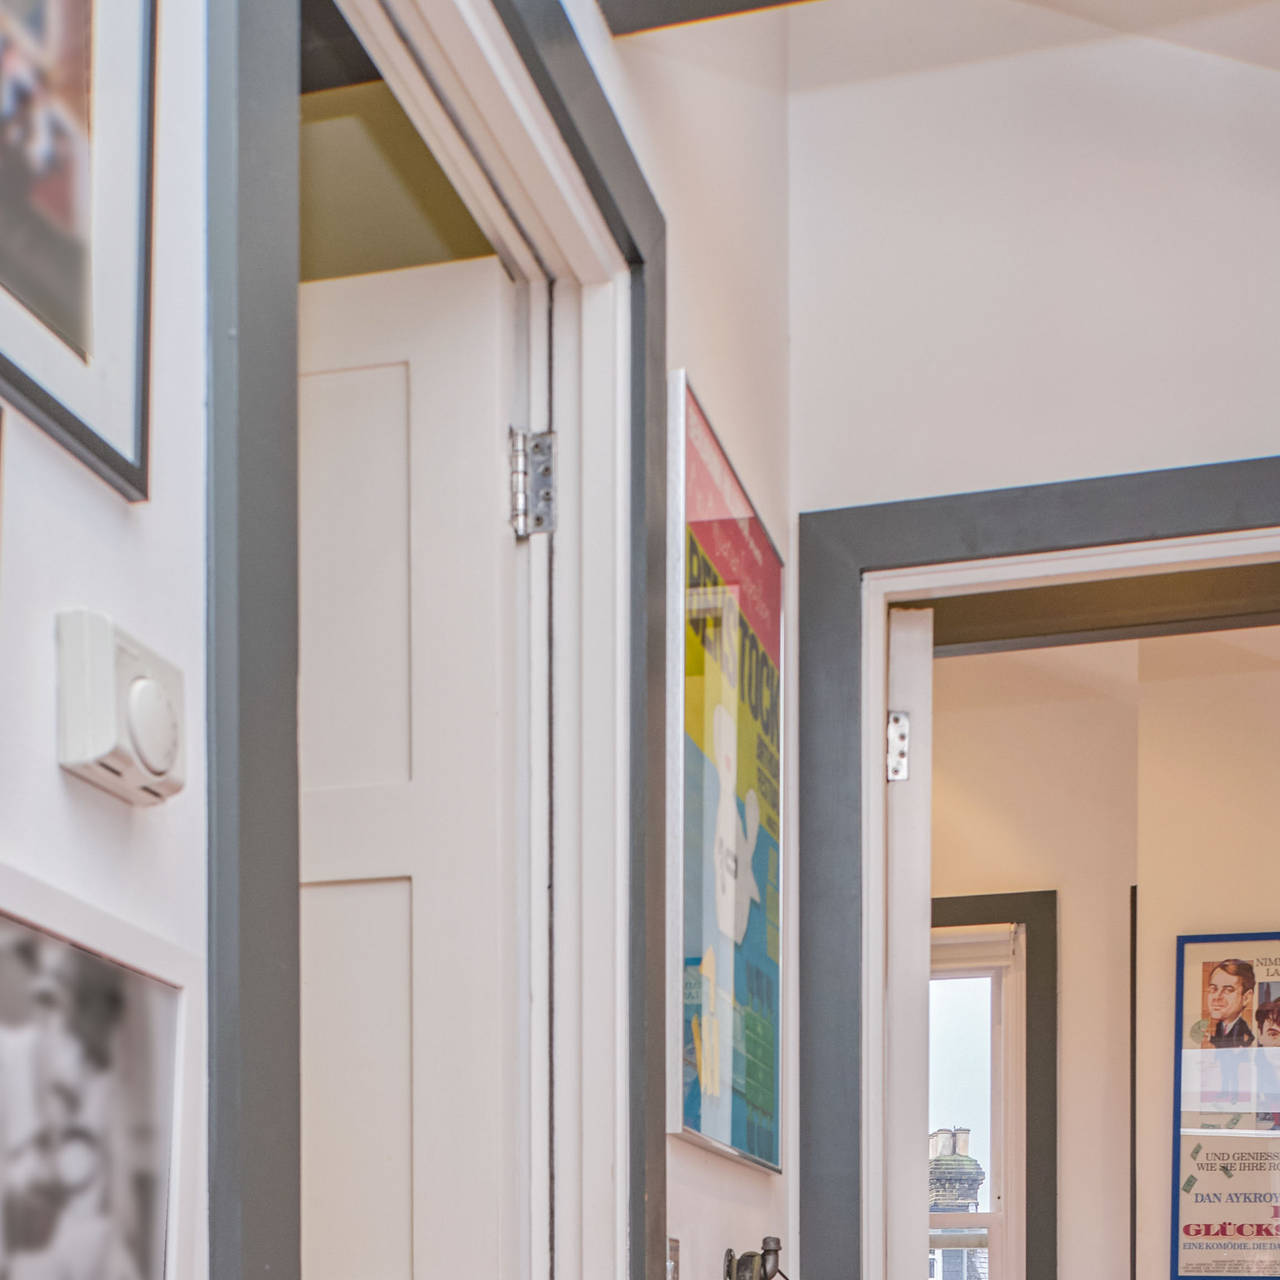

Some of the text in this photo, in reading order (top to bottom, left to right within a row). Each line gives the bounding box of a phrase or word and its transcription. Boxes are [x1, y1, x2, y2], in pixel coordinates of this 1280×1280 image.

[1205, 1152, 1230, 1161] UND
[1197, 1163, 1217, 1171] WIE
[1239, 1163, 1266, 1171] IHRE
[1195, 1192, 1221, 1203] DAN
